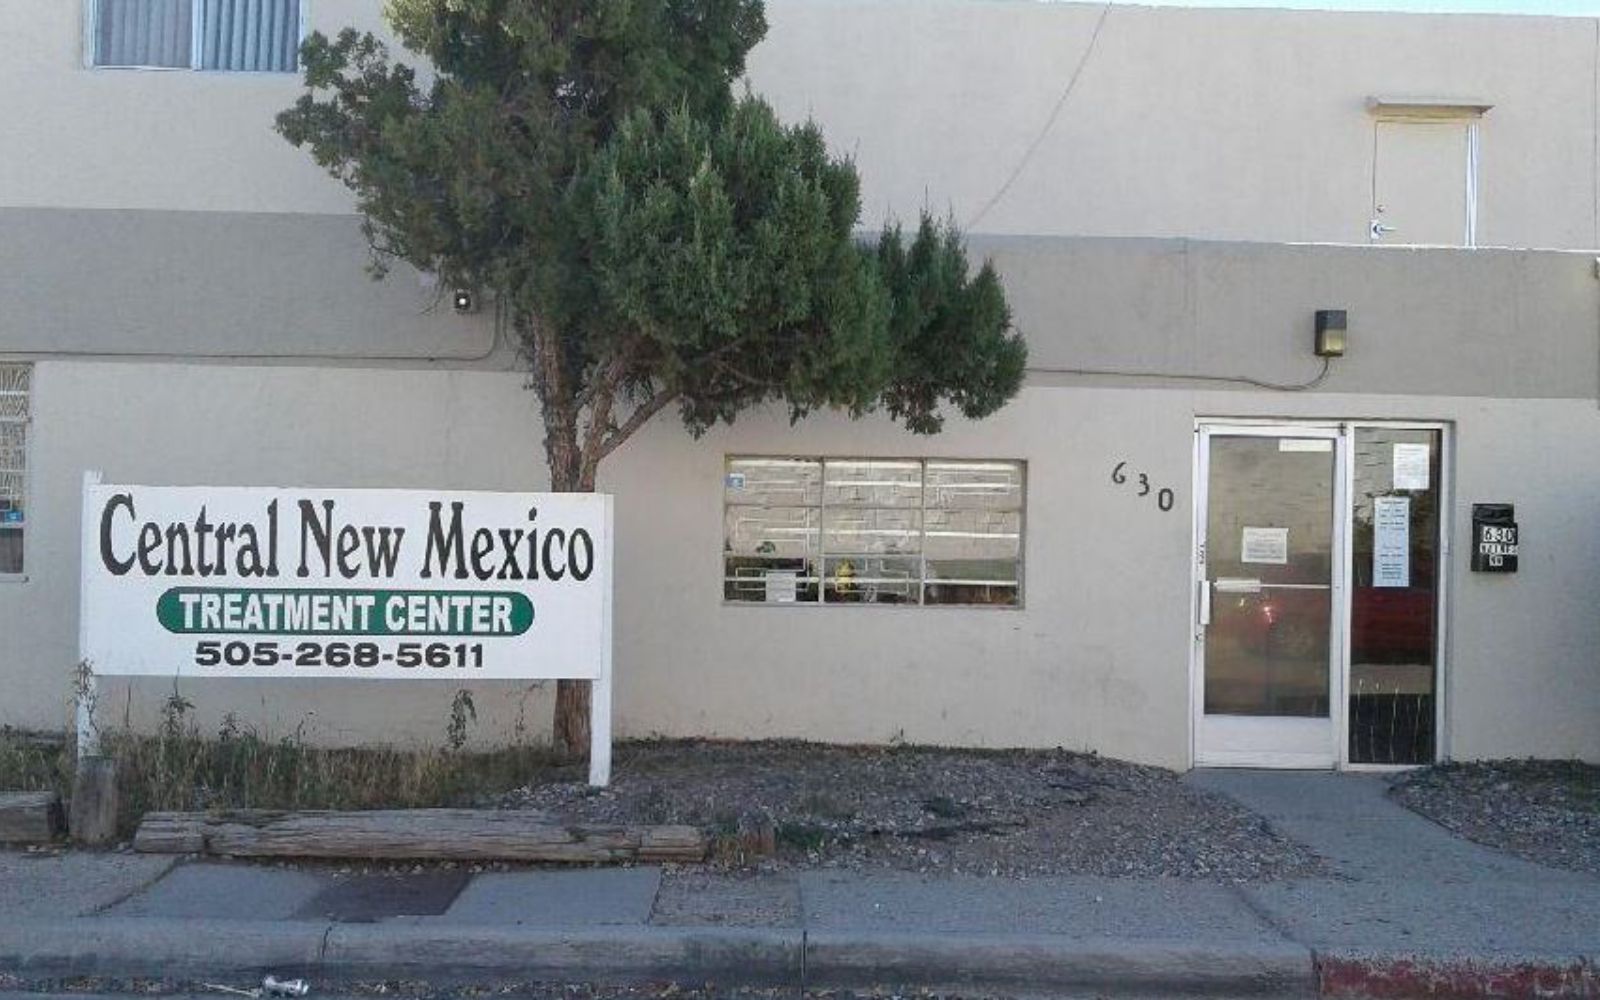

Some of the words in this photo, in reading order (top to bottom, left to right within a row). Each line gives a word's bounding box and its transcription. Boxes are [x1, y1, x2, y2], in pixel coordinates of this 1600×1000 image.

[1111, 462, 1175, 512] 630
[99, 493, 280, 578] Central
[297, 499, 406, 580] New
[419, 501, 595, 582] Mexico
[1484, 527, 1514, 542] 630
[178, 593, 376, 631] TREATMENT
[384, 595, 513, 633] CENTER
[195, 641, 484, 668] 505-268-5611
